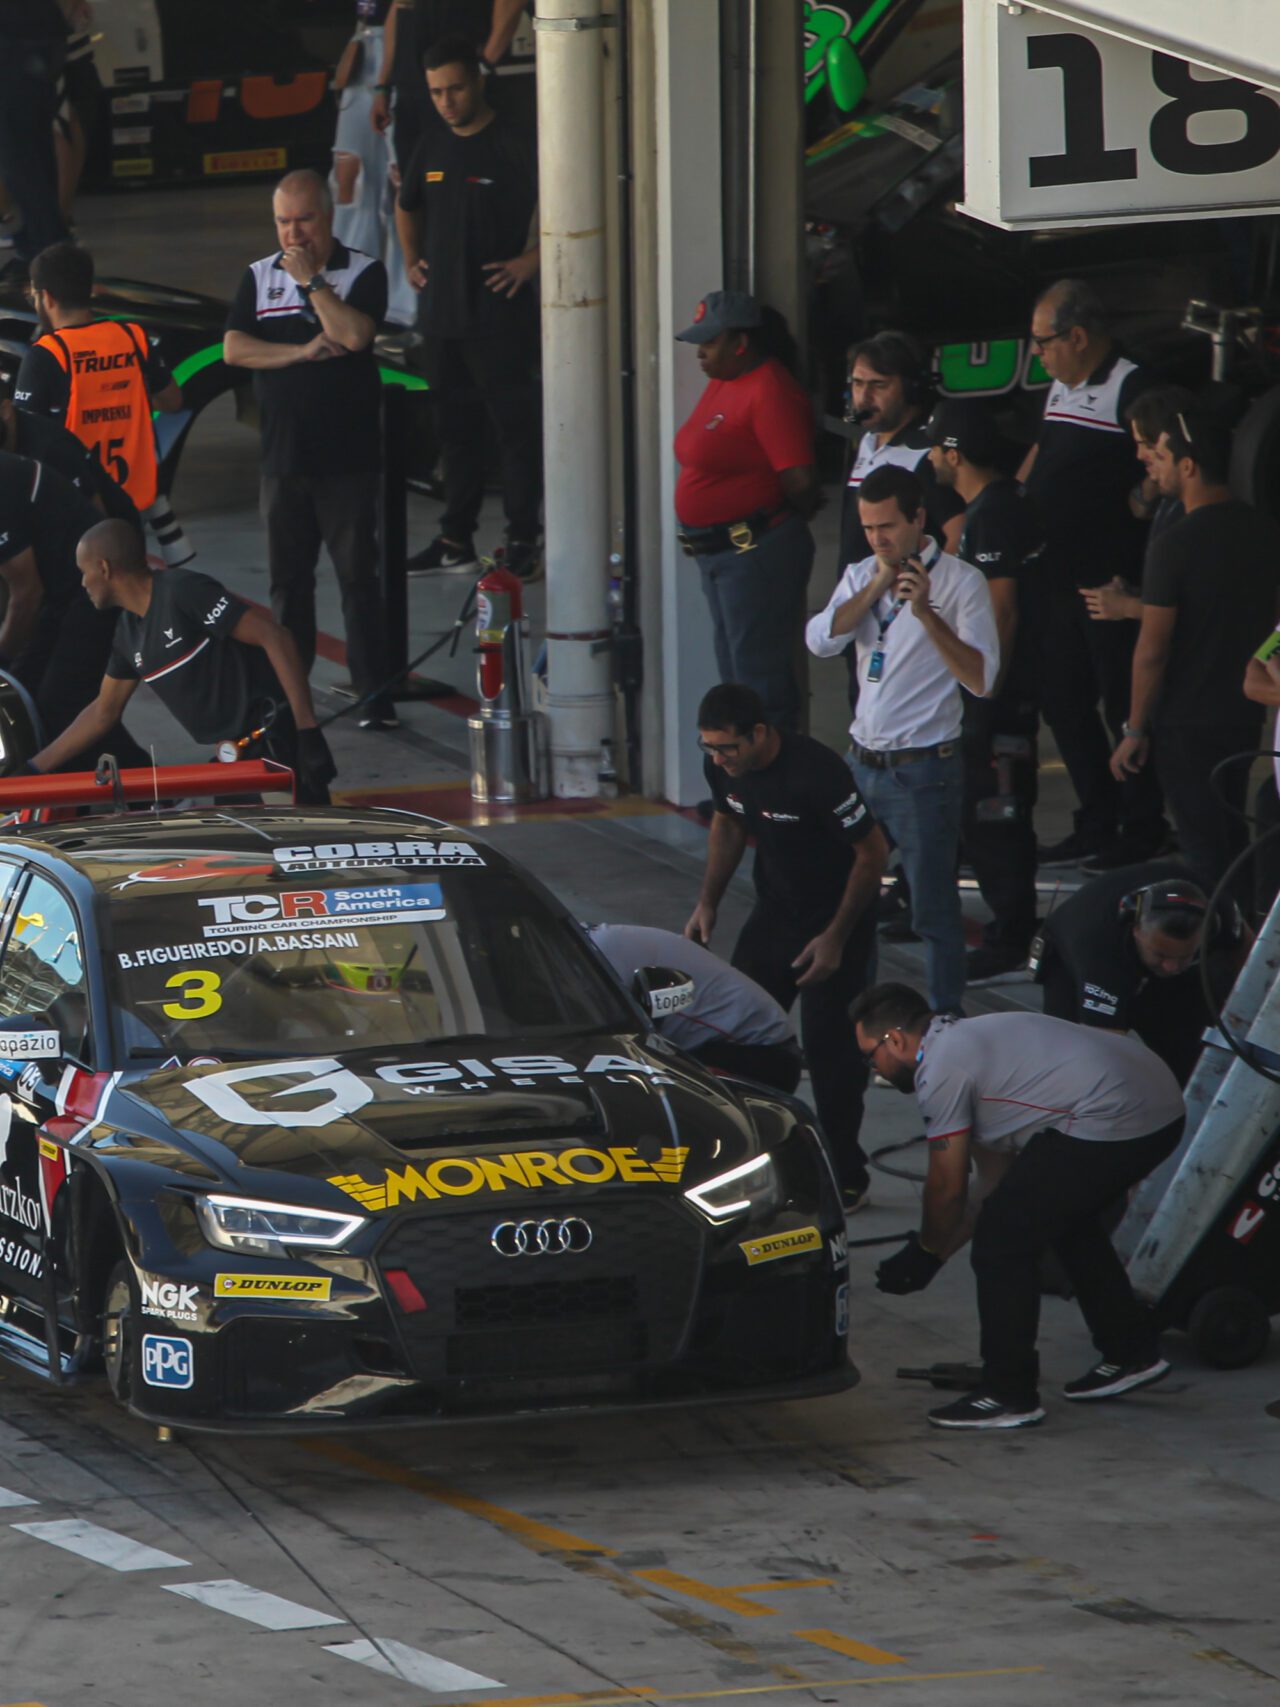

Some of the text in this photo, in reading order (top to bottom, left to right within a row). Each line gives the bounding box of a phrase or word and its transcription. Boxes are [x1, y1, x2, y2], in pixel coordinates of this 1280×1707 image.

[1027, 33, 1280, 188] 18
[73, 352, 137, 374] TRUCK
[14, 391, 31, 400] OLT
[203, 597, 229, 625] VOLT
[272, 841, 480, 862] COBRA
[286, 856, 484, 872] AUTOMOTIVA
[333, 888, 402, 901] South
[333, 896, 431, 912] America
[198, 890, 330, 924] TCR
[208, 914, 398, 935] TOURING CAR CHAMPIONSHIP
[162, 969, 223, 1020] 3
[375, 1054, 665, 1085] GISA
[386, 1146, 652, 1208] MONROE
[762, 1232, 816, 1253] DUNLOP
[141, 1280, 200, 1312] NGK
[238, 1279, 323, 1292] DUNLOP
[141, 1306, 198, 1321] SPARK PLUGS
